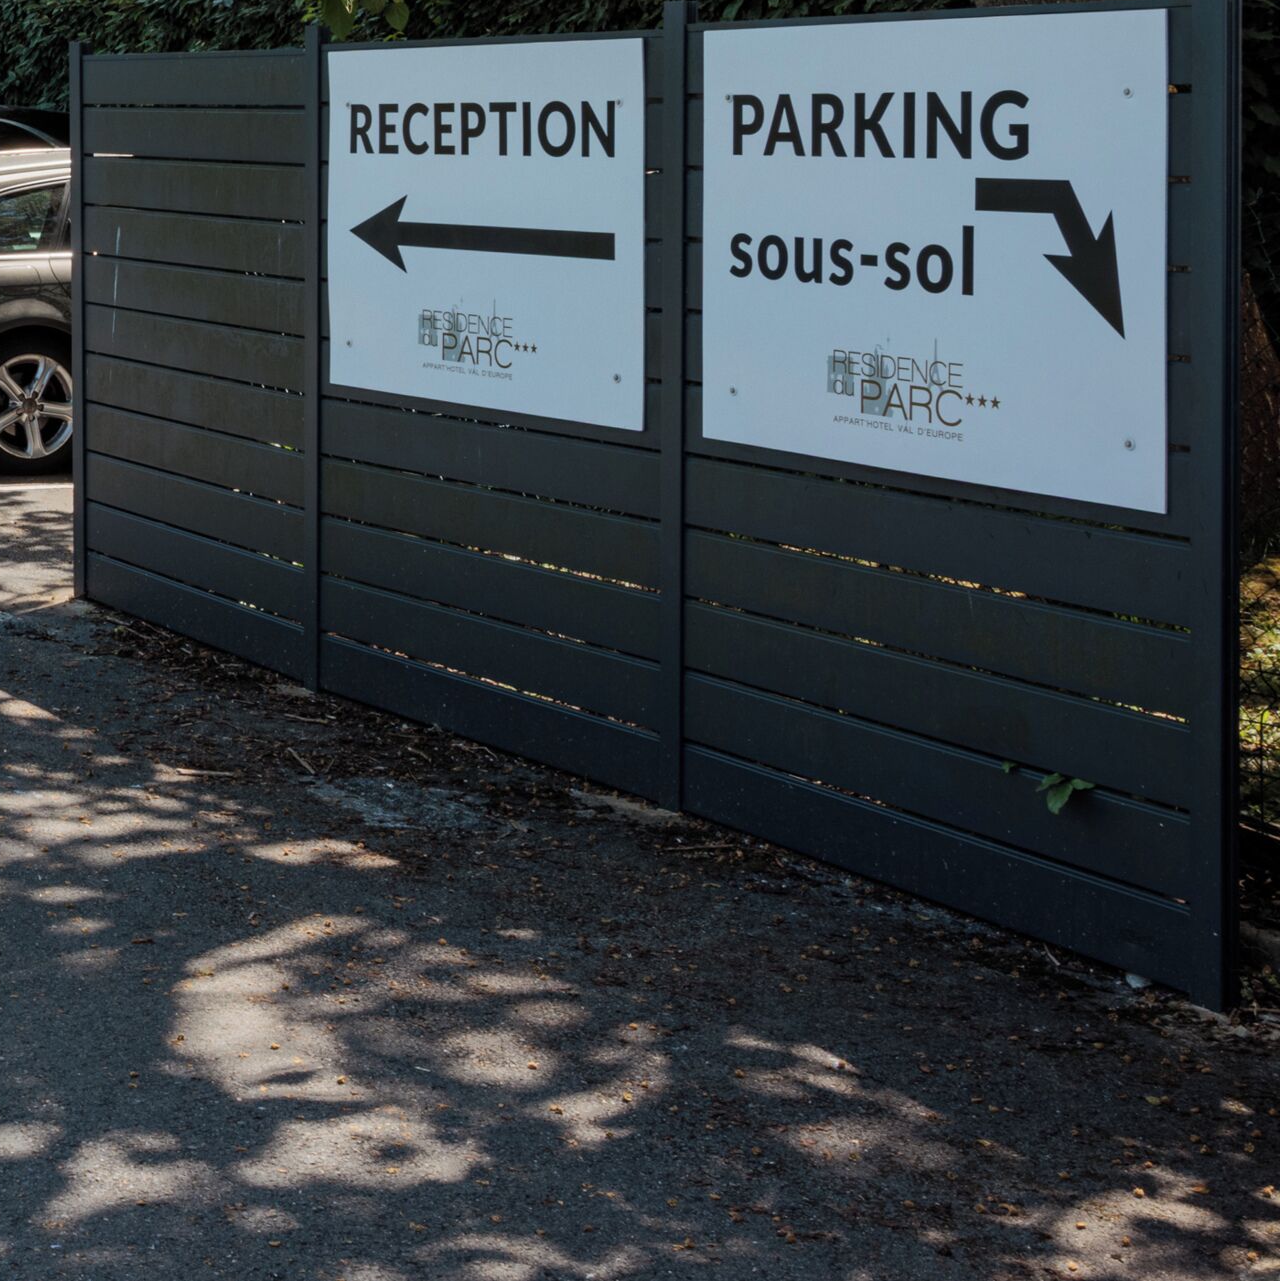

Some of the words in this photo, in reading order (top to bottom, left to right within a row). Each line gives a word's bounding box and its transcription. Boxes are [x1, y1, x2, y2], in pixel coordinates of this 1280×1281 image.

[349, 100, 616, 158] RECEPTION
[731, 90, 1030, 161] PARKING
[729, 225, 975, 296] sous-sol
[422, 309, 513, 338] RESIDENCE
[442, 332, 513, 369] PARC
[832, 349, 964, 389] RESIDENCE
[833, 376, 855, 397] du
[860, 379, 963, 427] PARC
[897, 424, 914, 435] VAL
[917, 427, 964, 442] D'EUROPE
